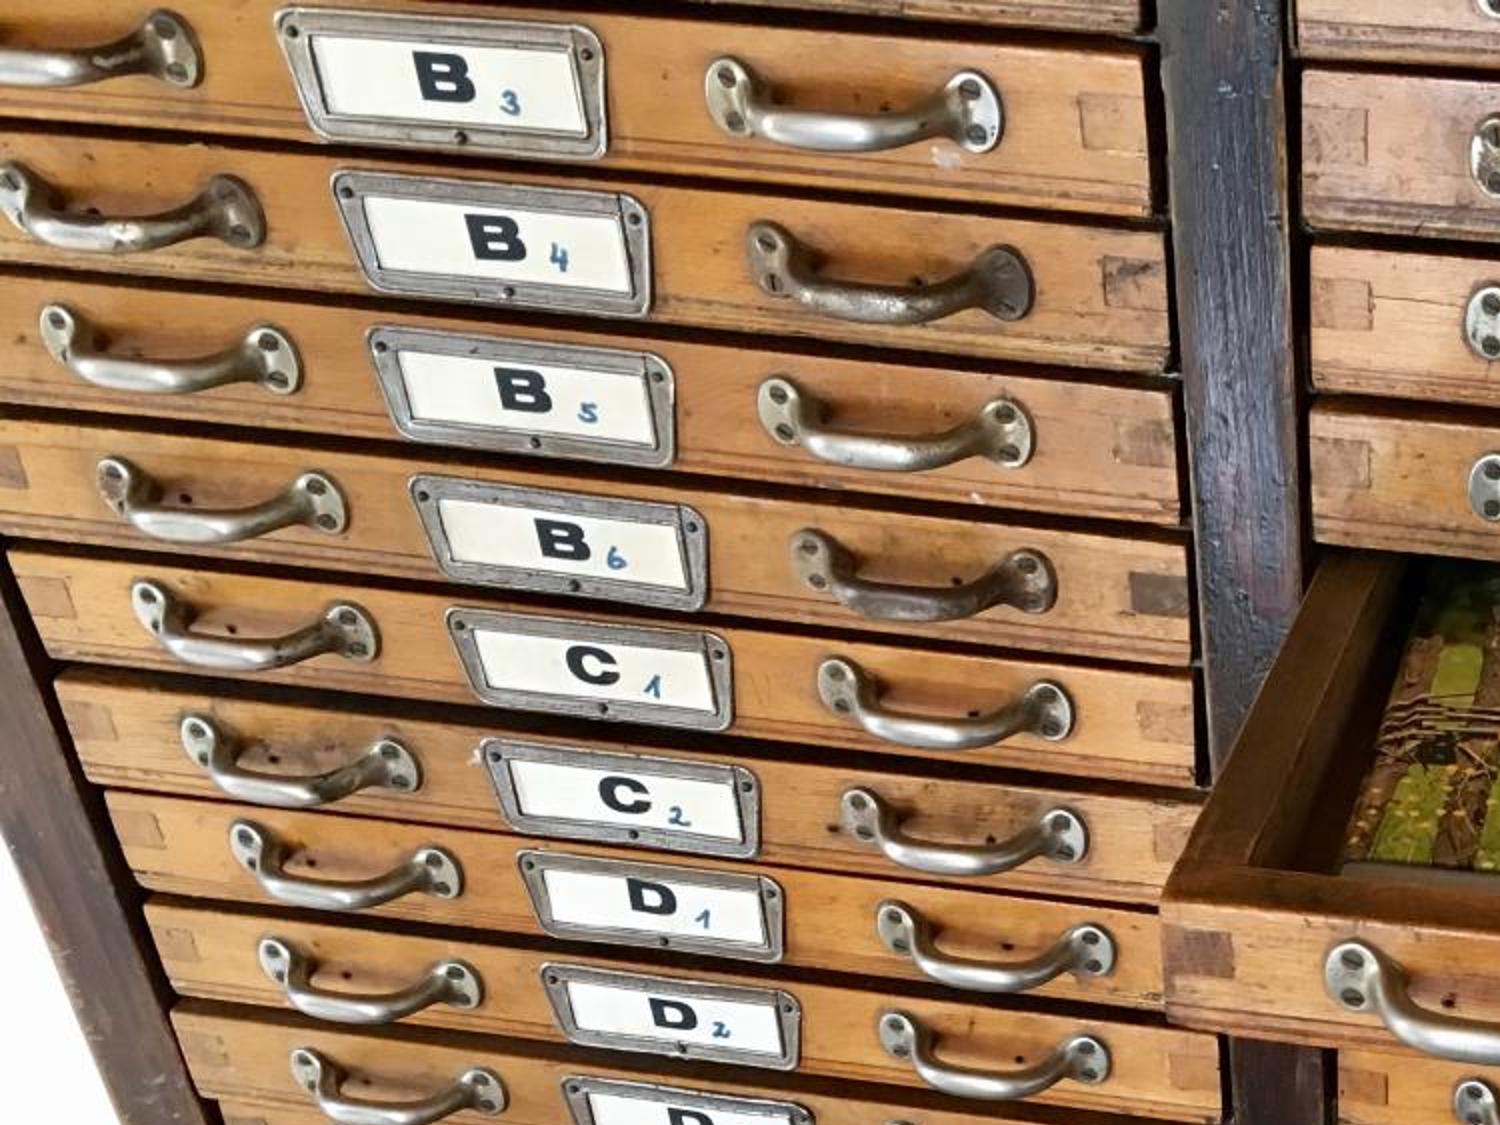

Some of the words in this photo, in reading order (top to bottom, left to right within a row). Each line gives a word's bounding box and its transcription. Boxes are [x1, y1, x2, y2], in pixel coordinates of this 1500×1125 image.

[412, 50, 475, 103] B
[500, 90, 522, 117] 3
[464, 213, 526, 262] B
[550, 243, 569, 273] 4
[493, 367, 552, 414] B
[578, 402, 599, 424] 5
[533, 518, 591, 561] B
[606, 546, 628, 571] 6
[566, 645, 621, 686] C
[643, 675, 661, 699] 1
[598, 776, 652, 815] C
[668, 806, 692, 828] 2
[626, 877, 678, 916] D
[695, 909, 712, 930] 1
[648, 997, 698, 1032] D
[712, 1020, 732, 1039] 2
